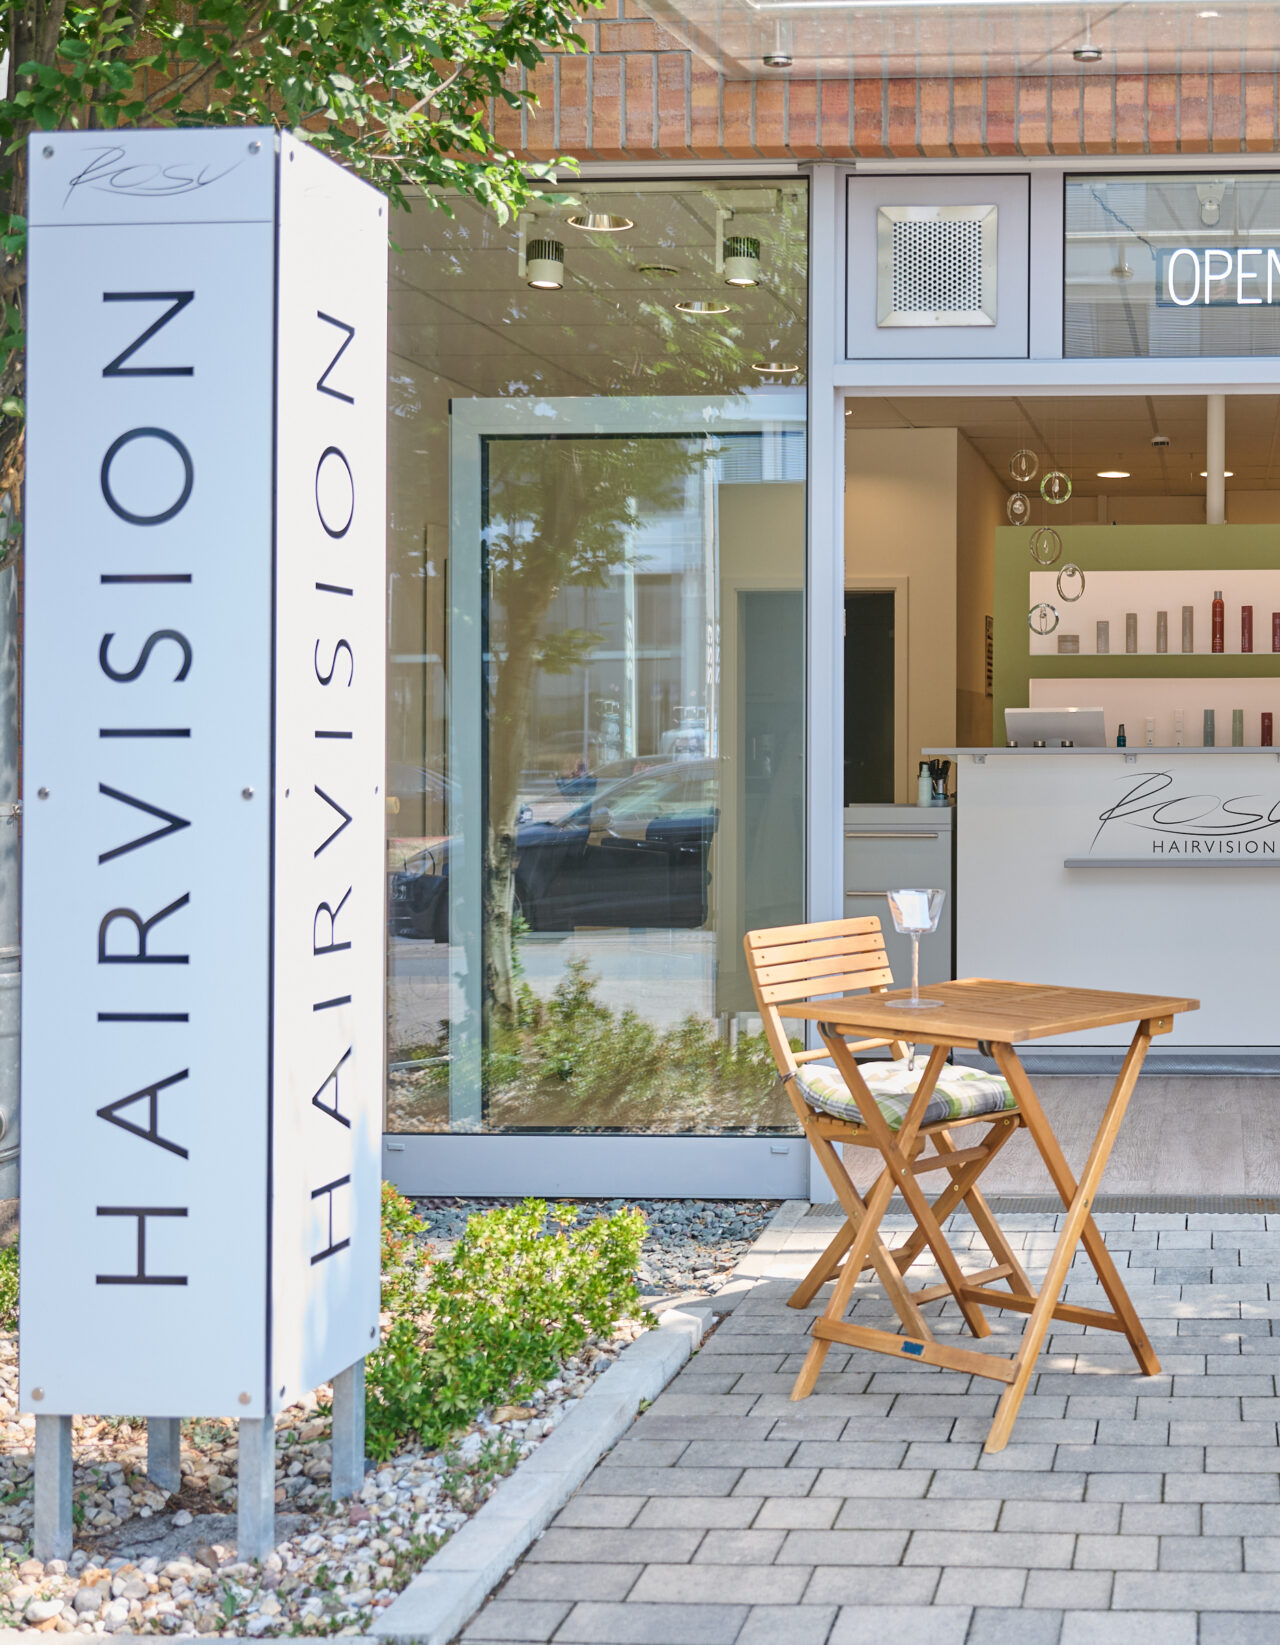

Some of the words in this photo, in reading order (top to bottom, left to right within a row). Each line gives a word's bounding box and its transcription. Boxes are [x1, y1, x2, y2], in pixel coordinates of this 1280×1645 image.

[96, 290, 195, 1287] HAIRVISION
[310, 309, 356, 1267] HAIRVISION
[1152, 840, 1276, 854] HAIRVISION
